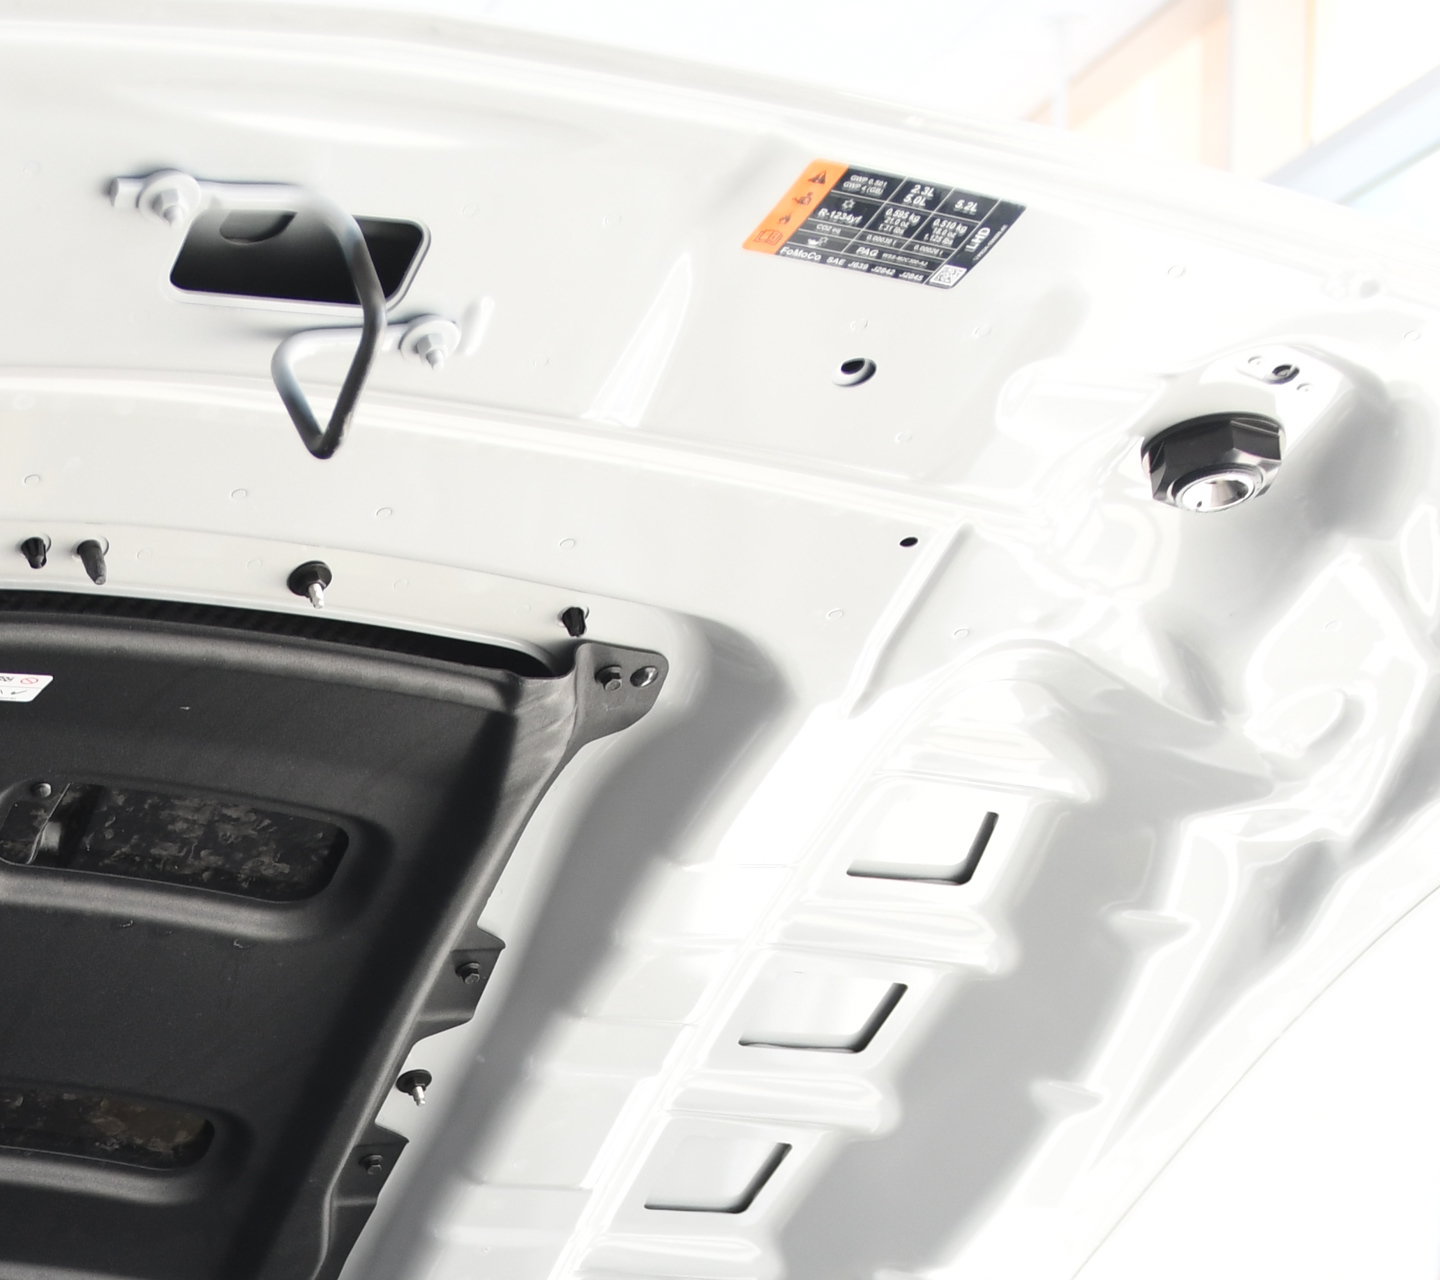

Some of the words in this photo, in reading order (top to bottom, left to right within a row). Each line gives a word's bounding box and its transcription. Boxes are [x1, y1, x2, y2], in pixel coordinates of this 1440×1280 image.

[850, 174, 868, 184] GWP
[843, 181, 861, 191] GWP
[911, 184, 935, 197] 2.3L
[903, 194, 926, 207] 5.0L
[955, 200, 978, 212] 5.2L
[909, 213, 921, 223] kg
[956, 223, 968, 233] kg
[965, 227, 991, 251] LHD
[780, 246, 822, 261] FoMoCo
[826, 256, 846, 266] SAE
